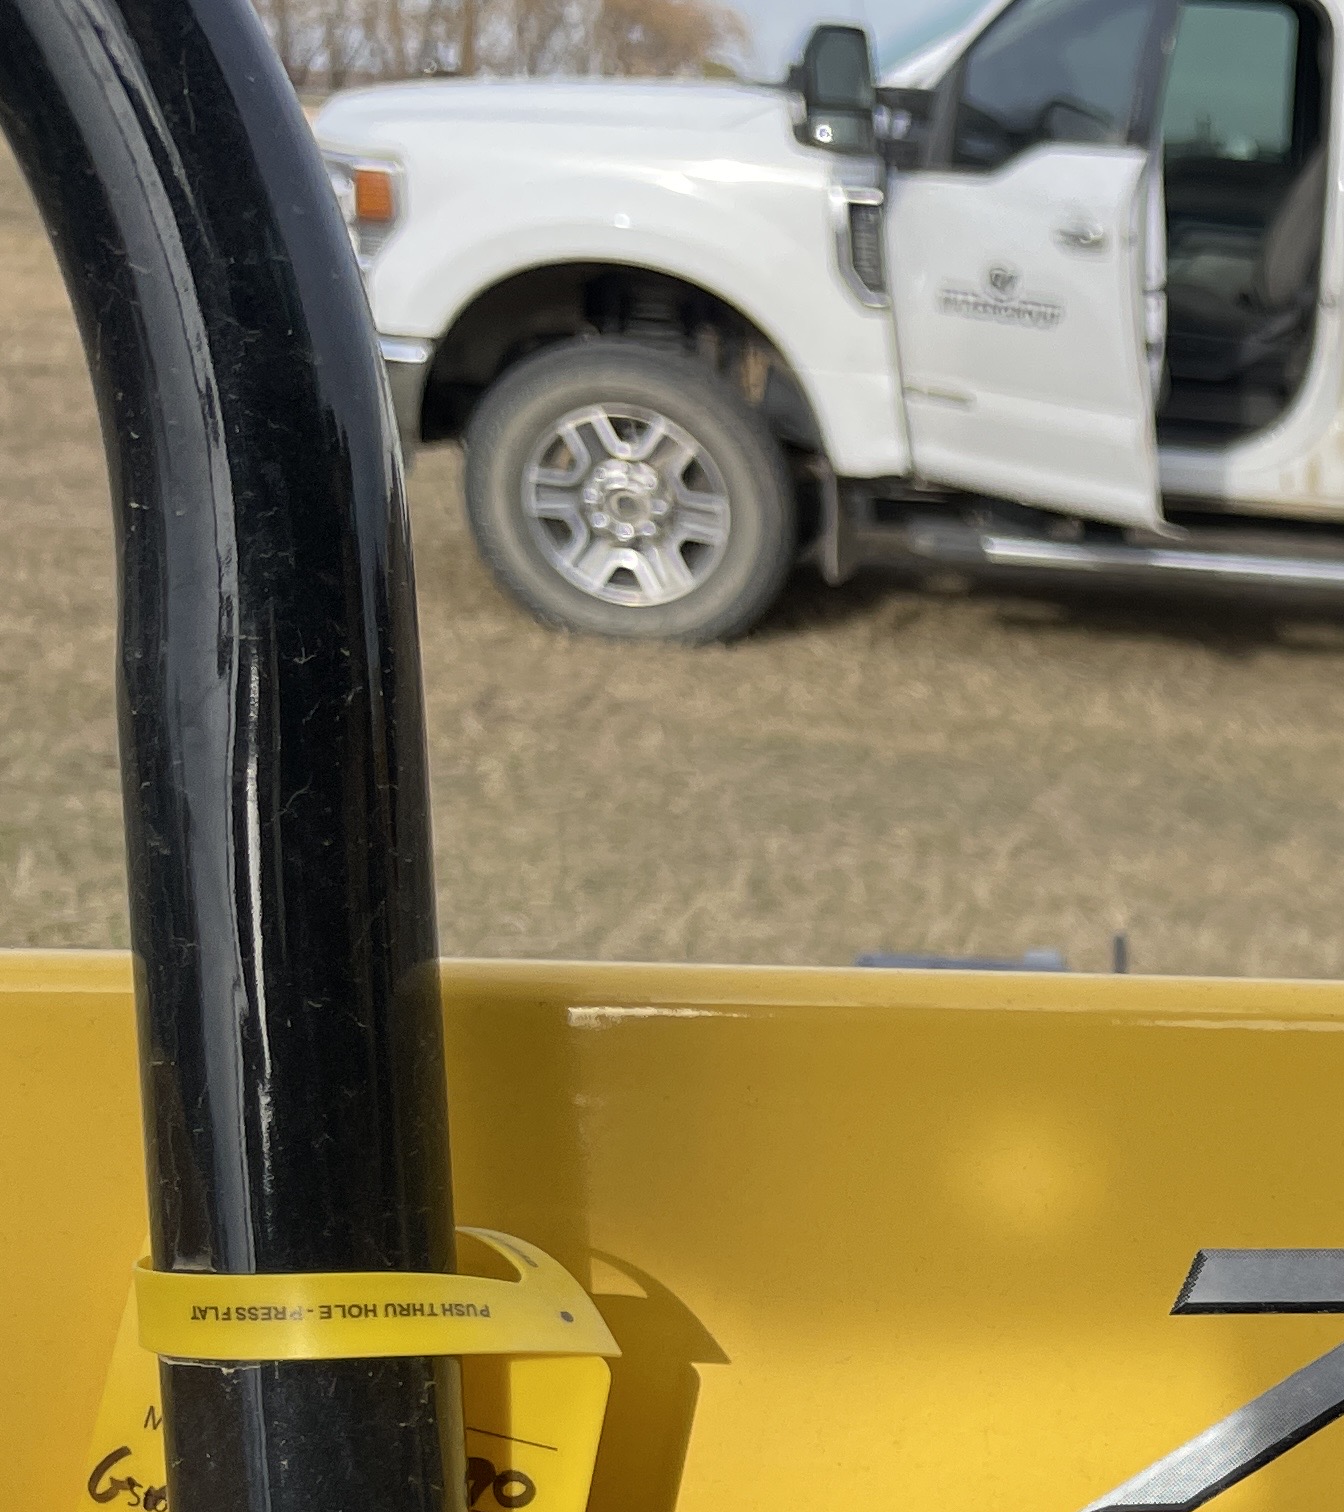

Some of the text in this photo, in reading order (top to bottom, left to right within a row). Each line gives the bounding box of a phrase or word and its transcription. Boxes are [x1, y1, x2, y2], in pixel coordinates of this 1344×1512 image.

[191, 1305, 232, 1320] FLAT
[235, 1305, 303, 1320] PRESS
[319, 1304, 377, 1319] HOLE
[384, 1303, 438, 1317] THRU
[442, 1303, 491, 1318] PUSH
